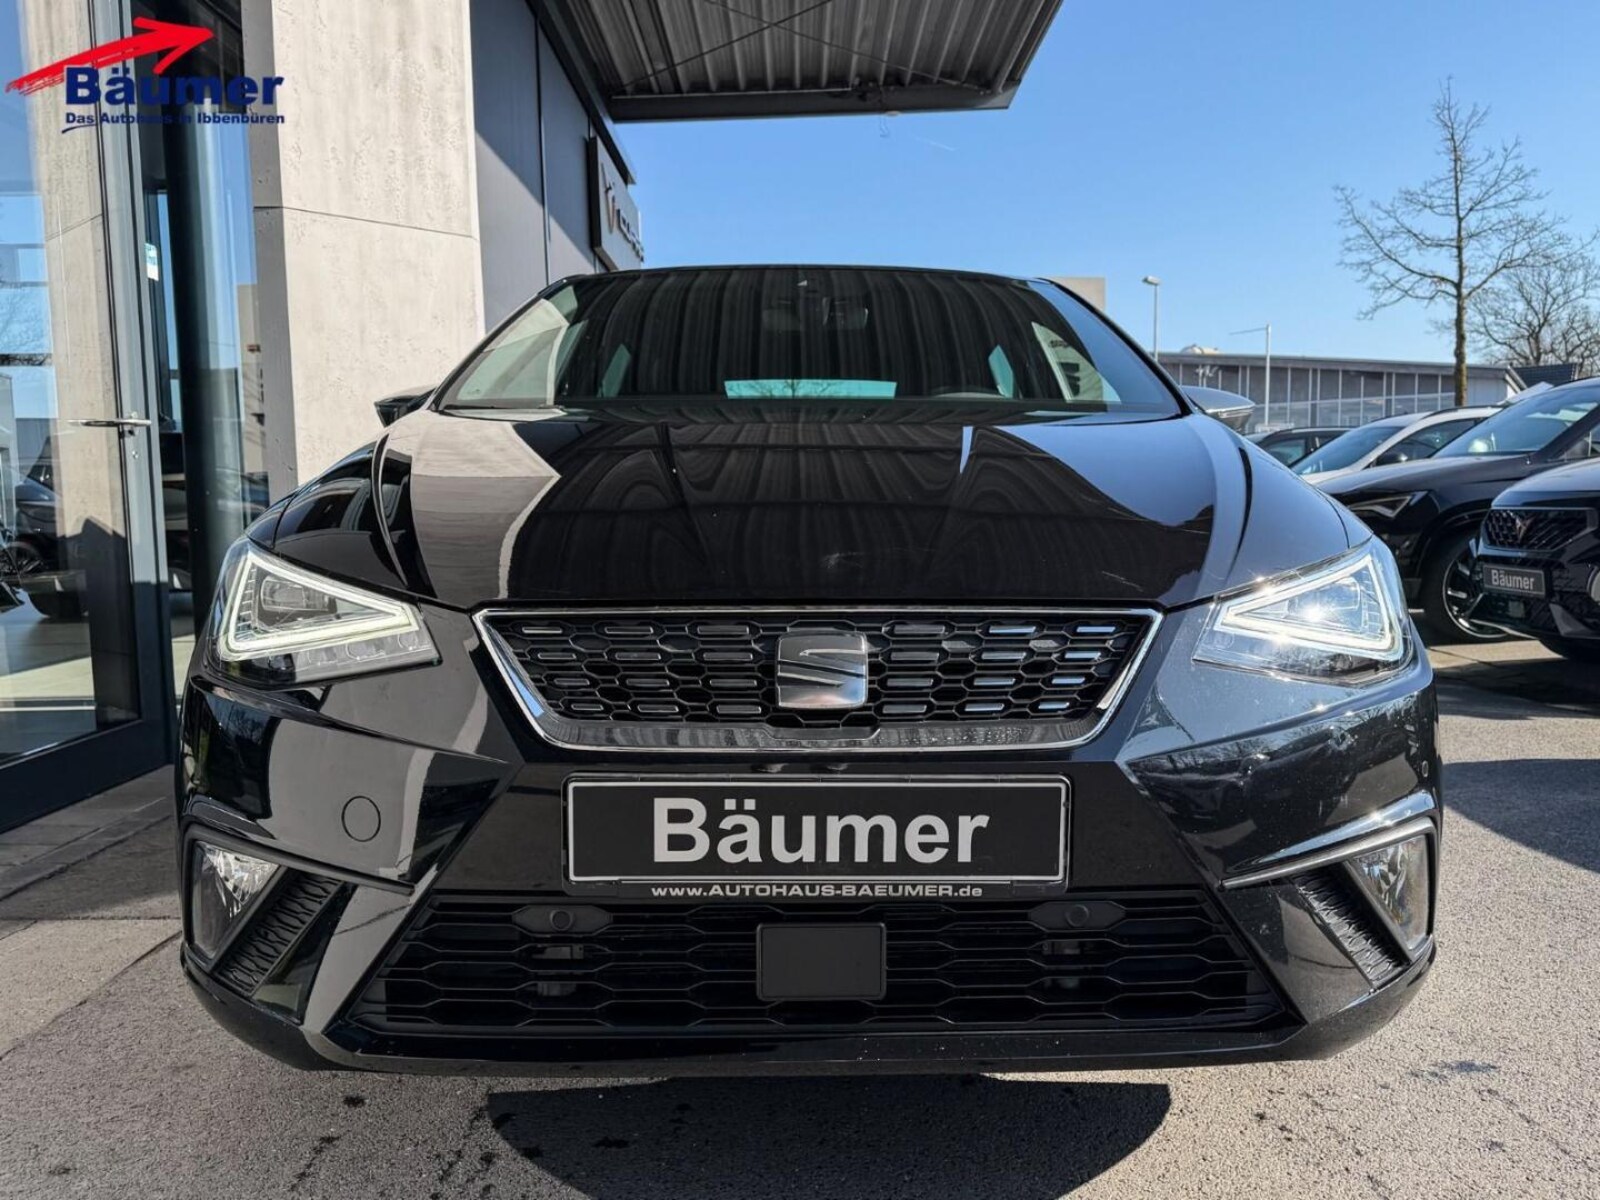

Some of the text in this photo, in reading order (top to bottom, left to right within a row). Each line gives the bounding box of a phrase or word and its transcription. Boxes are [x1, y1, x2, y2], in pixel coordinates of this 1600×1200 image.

[1491, 569, 1535, 590] Bäumer
[653, 797, 990, 863] Bäumer
[651, 884, 983, 897] www.AUTOHAUS-BAEUMER.de
